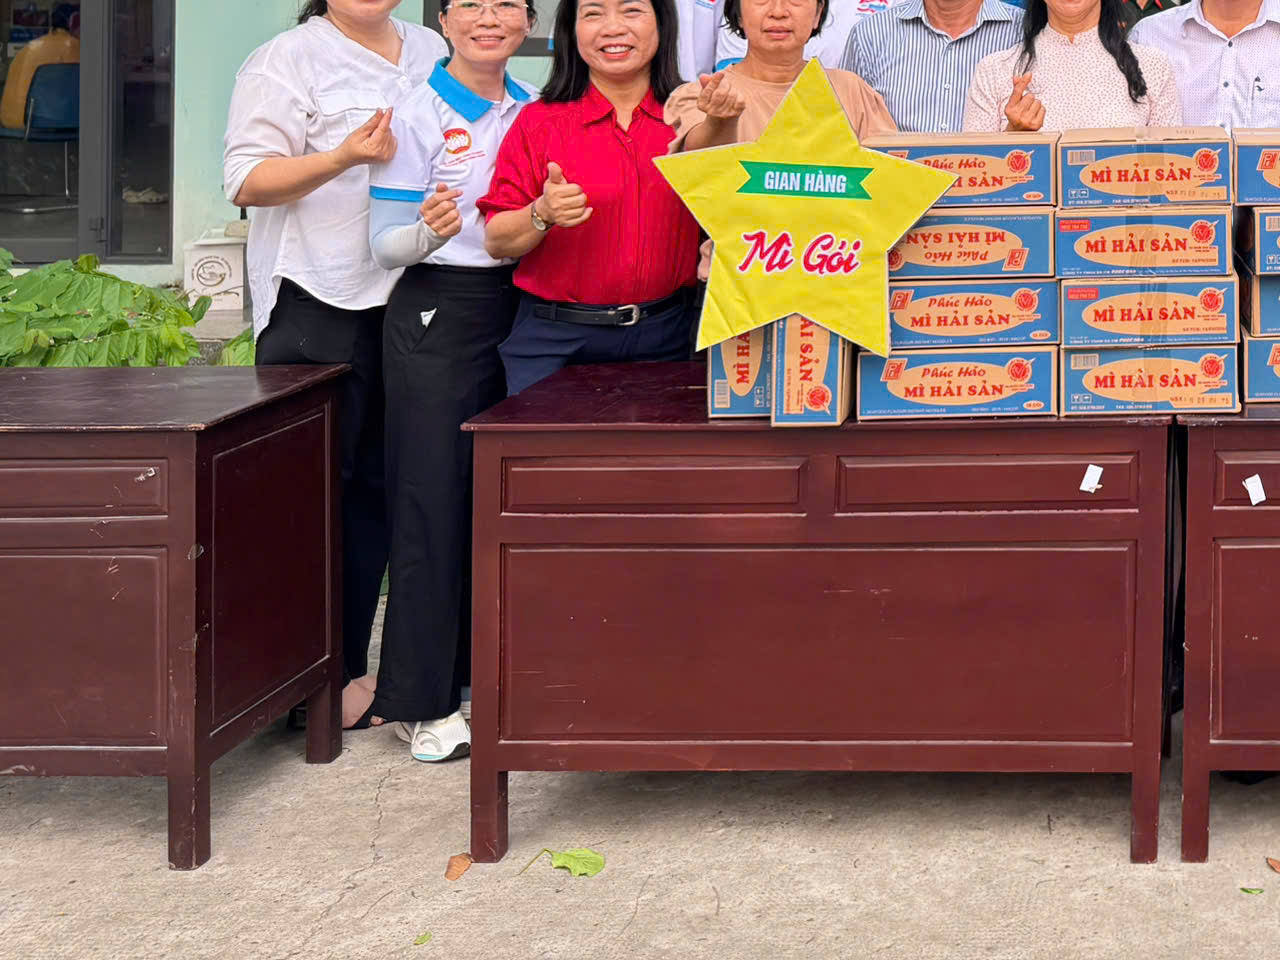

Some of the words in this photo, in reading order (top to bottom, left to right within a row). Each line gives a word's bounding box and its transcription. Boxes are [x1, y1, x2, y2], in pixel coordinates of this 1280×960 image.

[958, 157, 986, 169] Hảo
[764, 170, 801, 192] GIAN
[804, 169, 847, 194] HÀNG
[968, 171, 1005, 188] SẢN
[1090, 166, 1112, 183] MÌ
[1117, 163, 1149, 182] HẢI
[1155, 162, 1191, 181] SẢN
[906, 231, 942, 249] SẢN
[947, 231, 980, 248] HẢI
[985, 231, 1006, 246] MÌ
[1085, 236, 1107, 253] MÌ
[1112, 232, 1145, 253] HẢI
[1150, 232, 1188, 252] SẢN
[738, 230, 794, 273] Mì
[803, 234, 861, 275] Gói
[956, 250, 989, 262] Phúc
[928, 297, 960, 308] Phúc
[964, 295, 992, 307] Hảo
[910, 313, 932, 327] MÌ
[936, 310, 969, 327] HẢI
[974, 309, 1010, 326] SẢN
[1092, 305, 1115, 322] MÌ
[1119, 302, 1153, 321] HẢI
[1158, 301, 1196, 320] SẢN
[800, 343, 820, 382] SẢN
[921, 366, 953, 378] Phúc
[957, 365, 986, 377] Hảo
[732, 363, 750, 384] MÌ
[1094, 371, 1116, 388] MÌ
[1120, 368, 1153, 388] HẢI
[1159, 368, 1196, 387] SẢN
[903, 384, 926, 398] MÌ
[929, 380, 962, 397] HẢI
[967, 380, 1003, 396] SẢN
